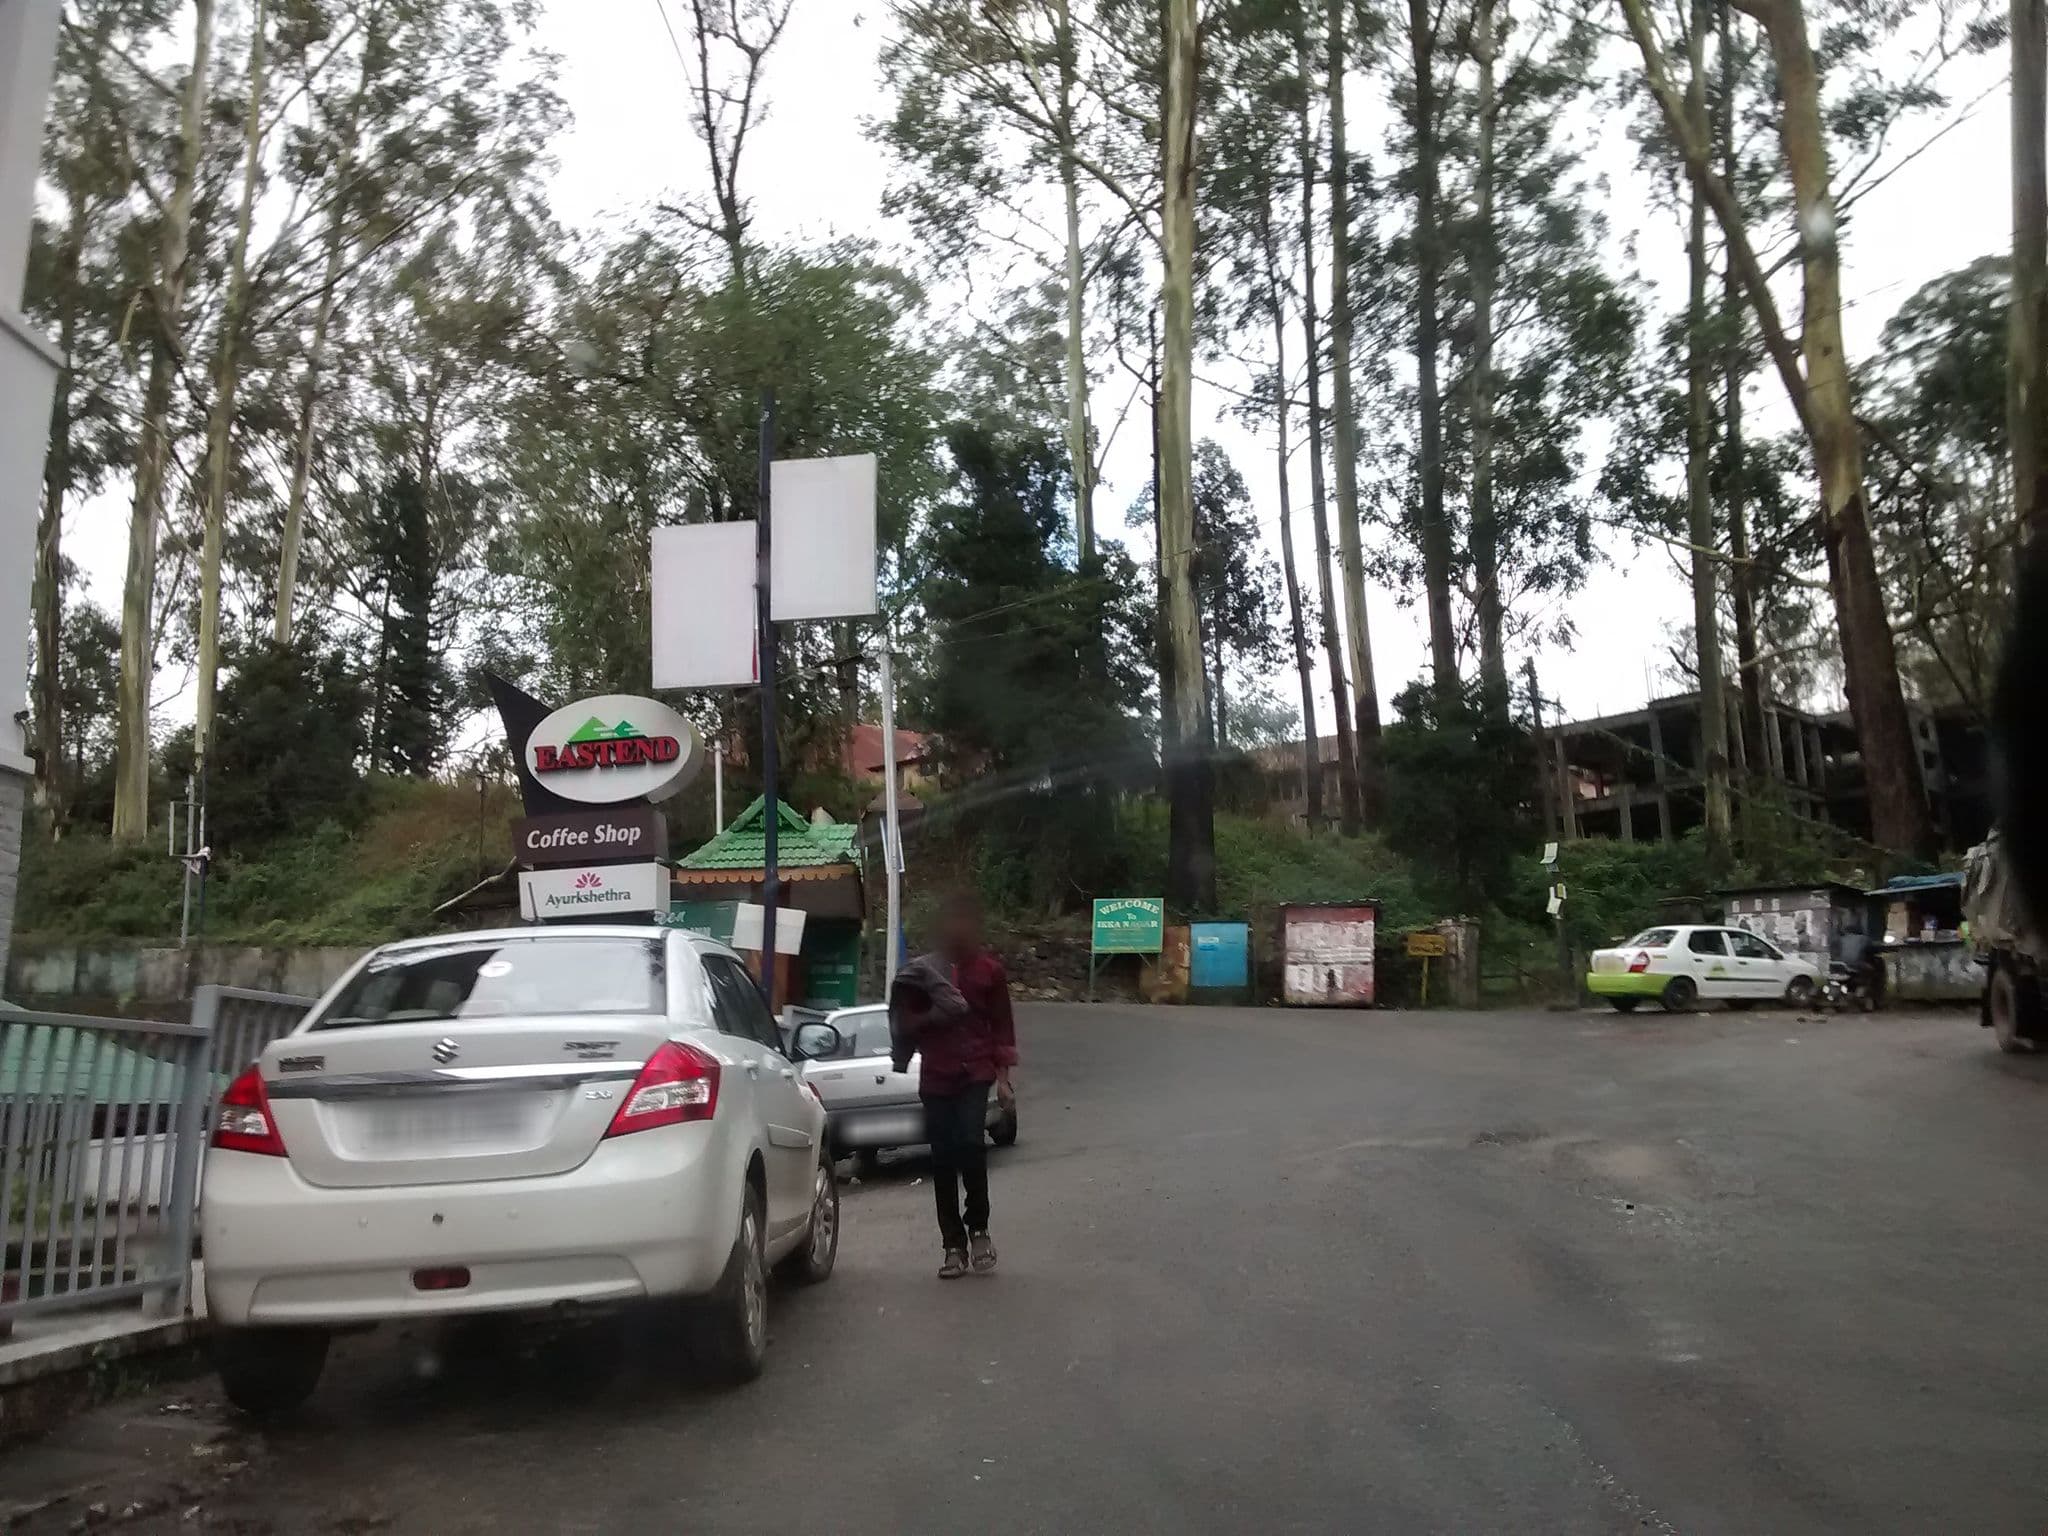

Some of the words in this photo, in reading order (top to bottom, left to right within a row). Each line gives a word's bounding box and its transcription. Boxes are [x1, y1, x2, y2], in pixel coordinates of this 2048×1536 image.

[534, 736, 681, 773] EASTEND
[526, 827, 588, 849] Coffee
[594, 824, 641, 846] Shop
[545, 888, 631, 908] Ayurkshethra
[1099, 900, 1159, 915] WELCOME
